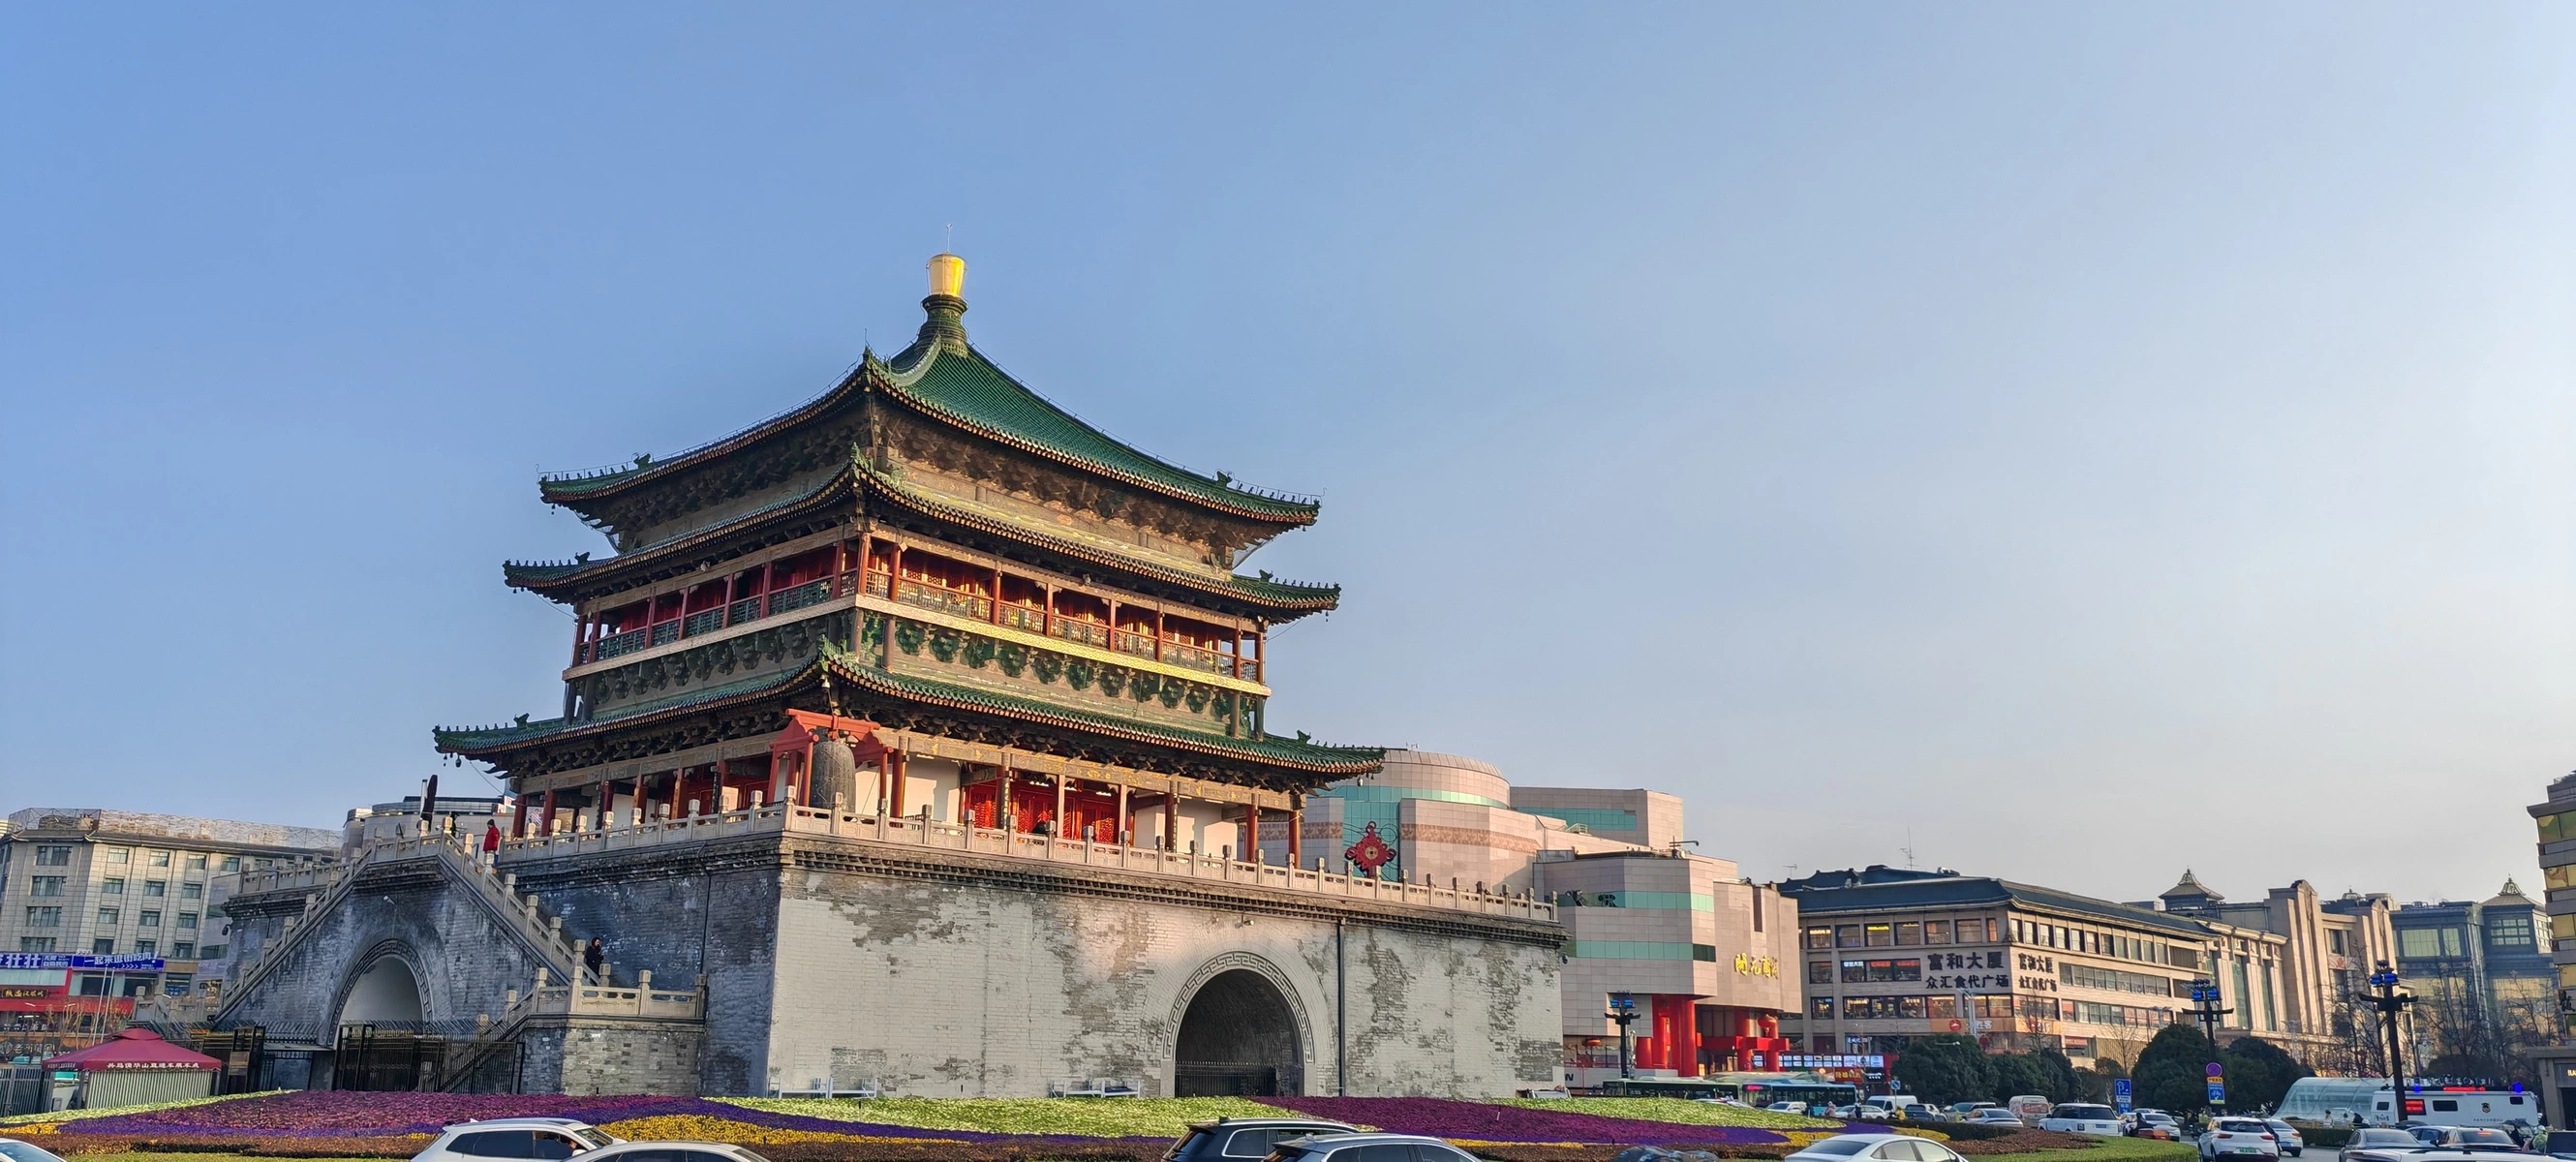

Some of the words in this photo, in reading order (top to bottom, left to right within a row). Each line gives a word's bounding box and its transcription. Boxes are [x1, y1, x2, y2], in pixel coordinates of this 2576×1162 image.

[0, 954, 41, 968] 壮壮
[1927, 952, 2004, 970] 富和大厦
[1926, 974, 2009, 989] 众汇食代广场
